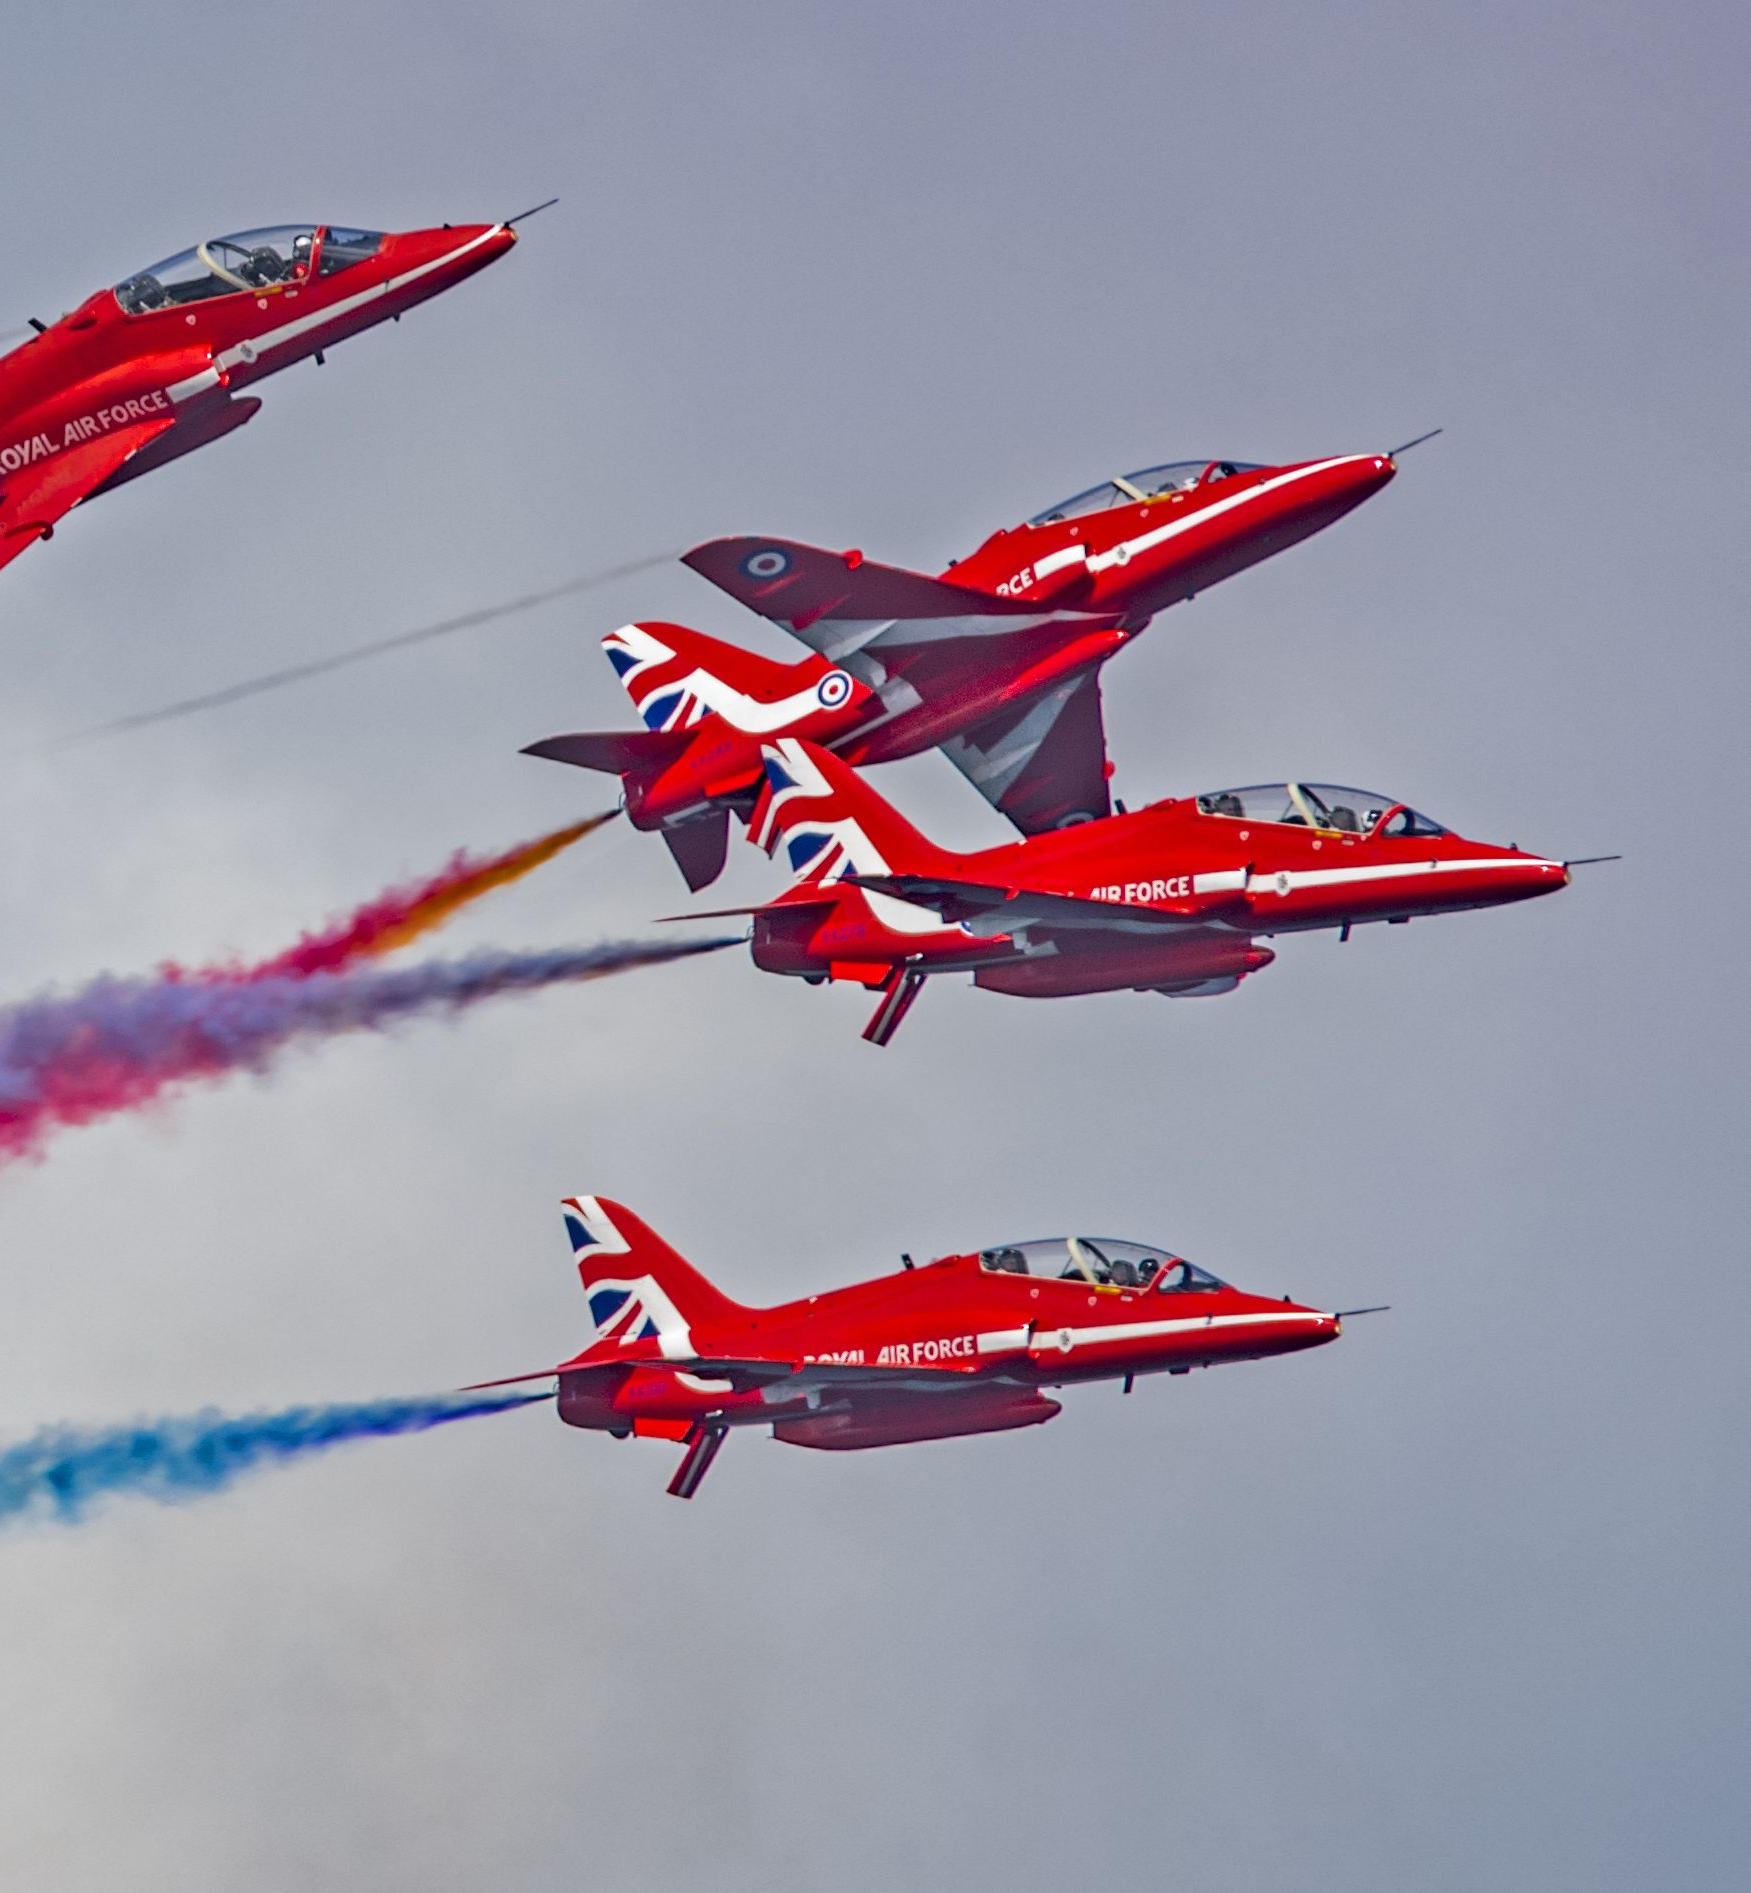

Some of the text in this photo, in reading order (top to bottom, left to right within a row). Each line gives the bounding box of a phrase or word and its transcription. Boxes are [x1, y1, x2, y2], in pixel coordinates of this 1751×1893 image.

[64, 416, 102, 446] AIR
[97, 390, 168, 429] FORCE
[995, 566, 1034, 597] RCE
[1124, 875, 1191, 904] FORCE
[876, 1343, 911, 1364] AIR
[913, 1335, 975, 1365] FORCE
